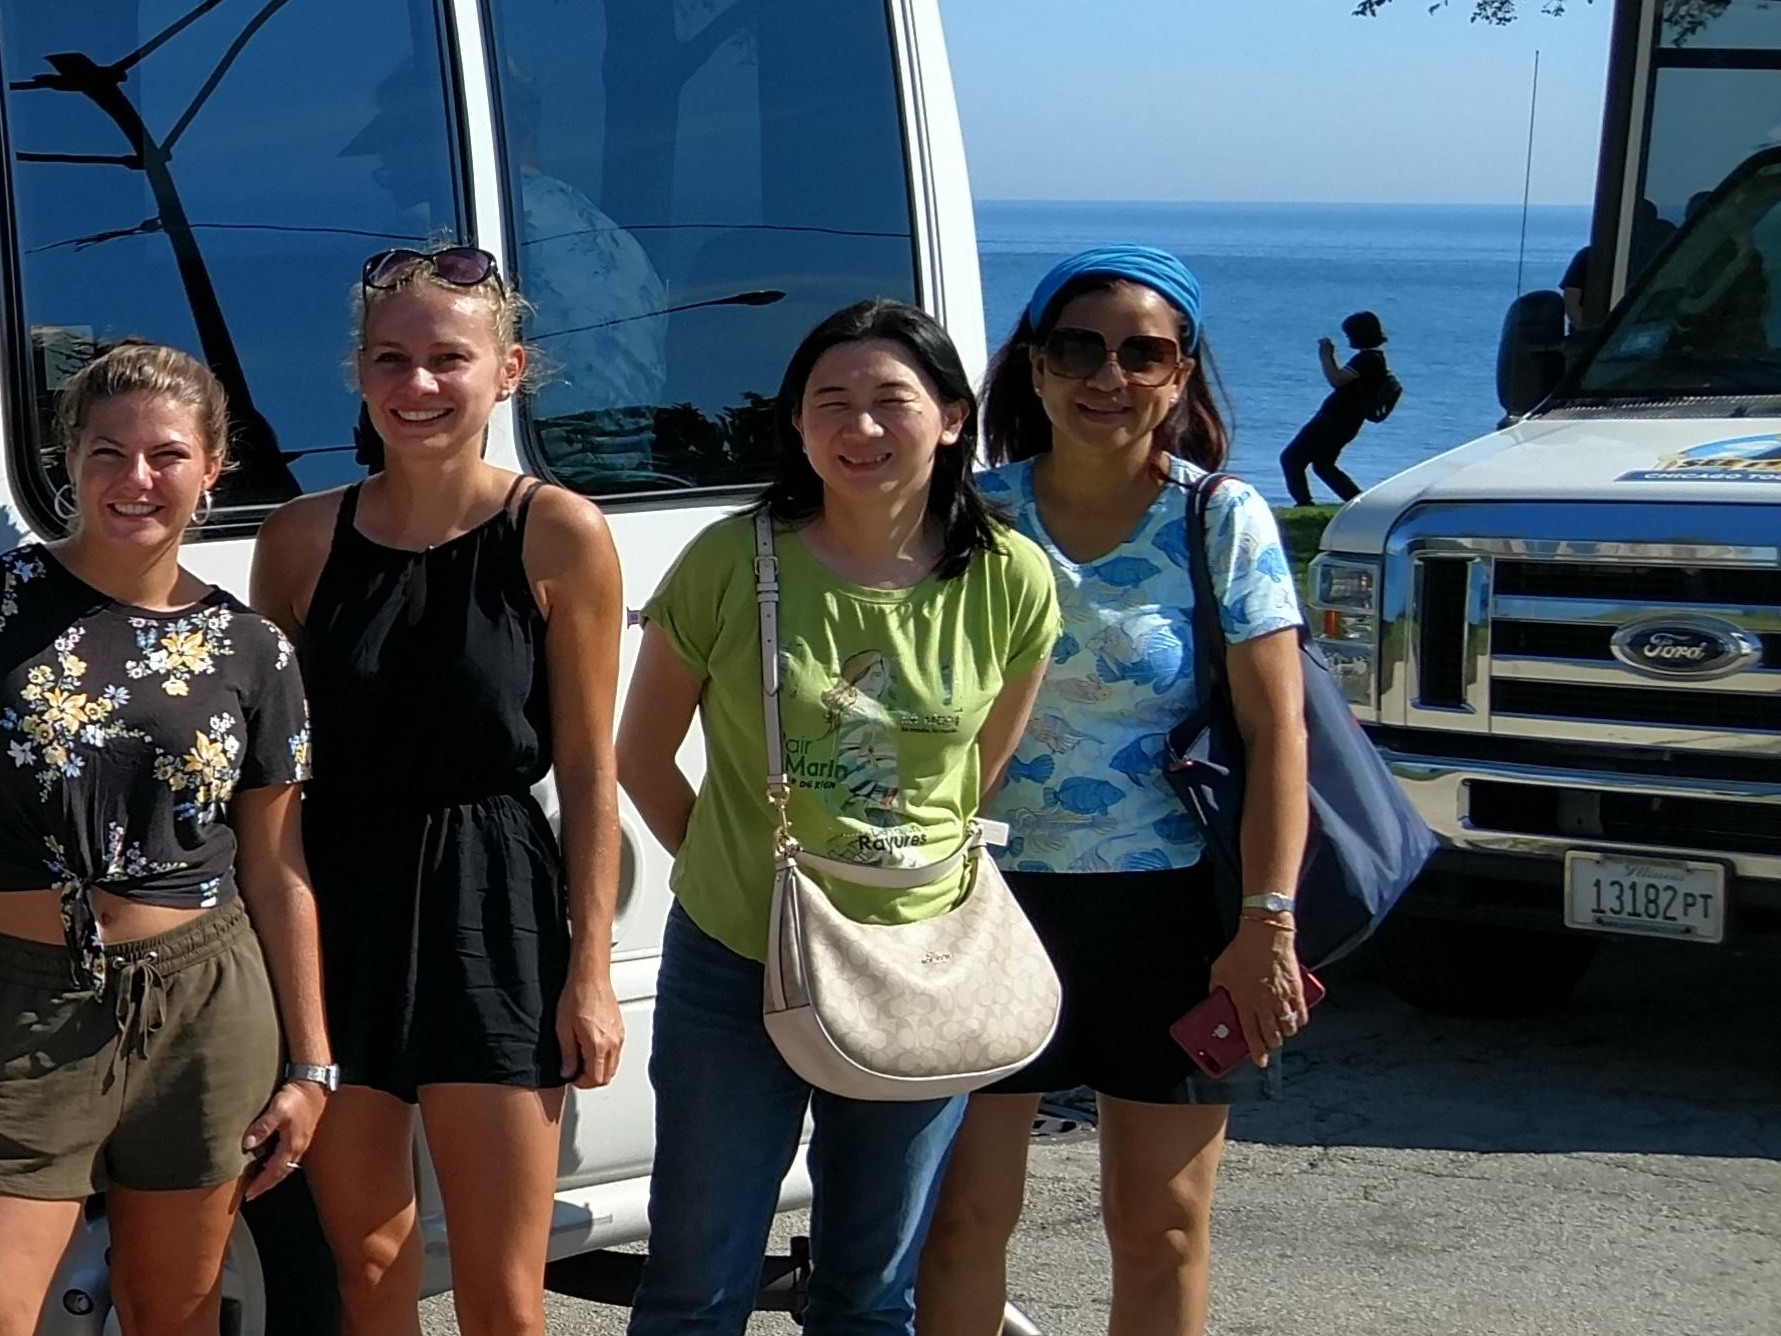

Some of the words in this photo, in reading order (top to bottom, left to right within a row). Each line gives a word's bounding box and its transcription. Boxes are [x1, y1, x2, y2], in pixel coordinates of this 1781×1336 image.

[1644, 472, 1742, 480] CHICAGO
[1643, 632, 1708, 660] Ford
[859, 833, 927, 855] Rayures
